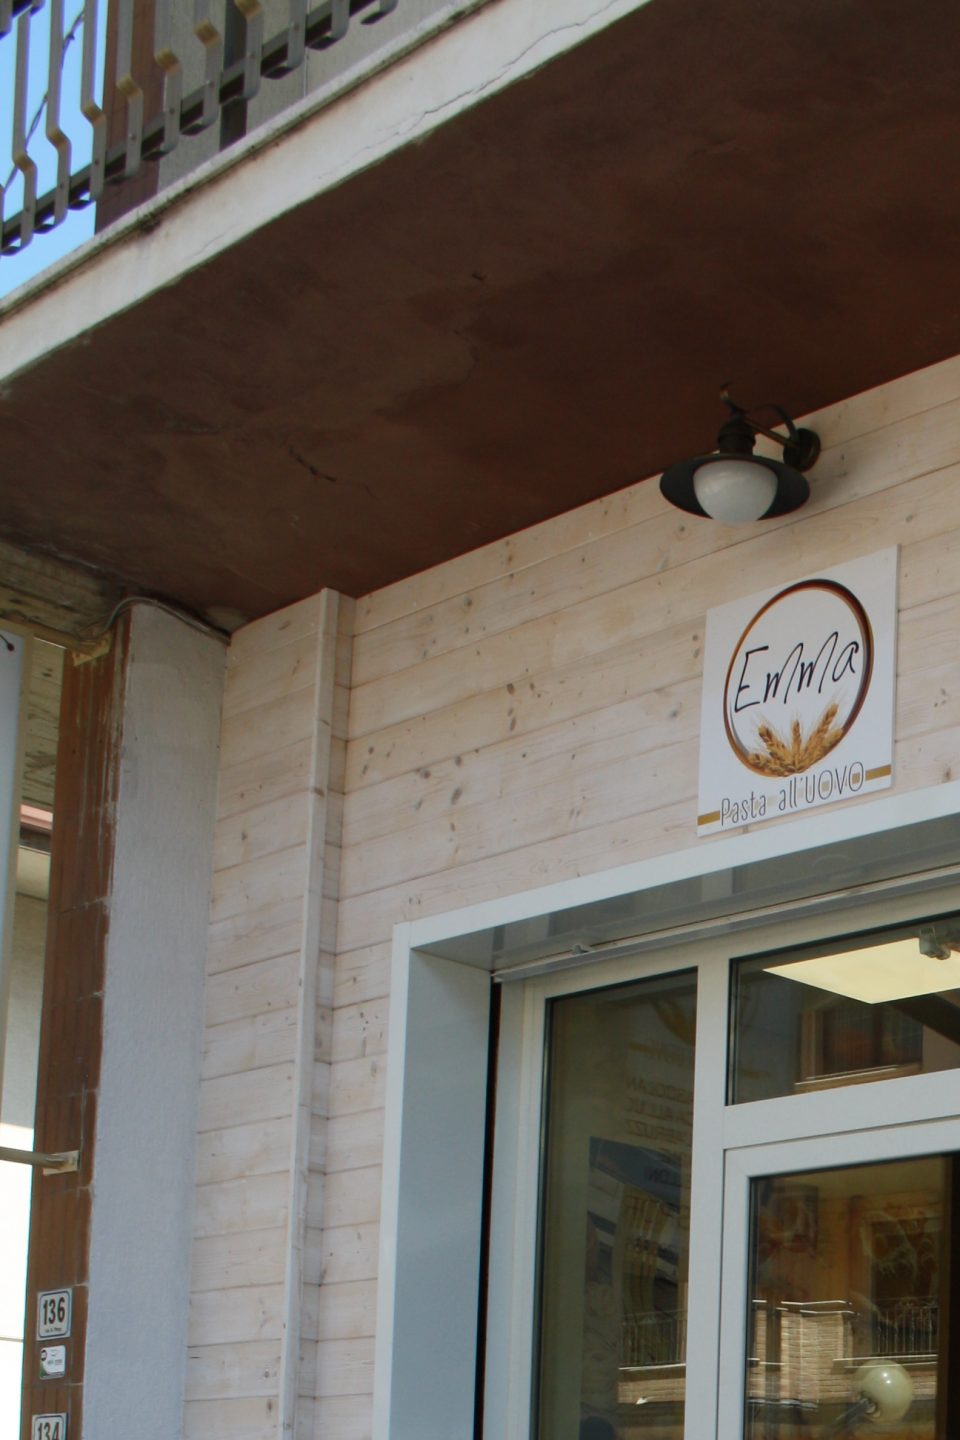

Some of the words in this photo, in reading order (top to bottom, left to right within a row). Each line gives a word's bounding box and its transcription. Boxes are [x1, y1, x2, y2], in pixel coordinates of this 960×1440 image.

[721, 791, 767, 826] Pasta
[778, 761, 864, 811] all'UOVO
[42, 1297, 65, 1325] 136
